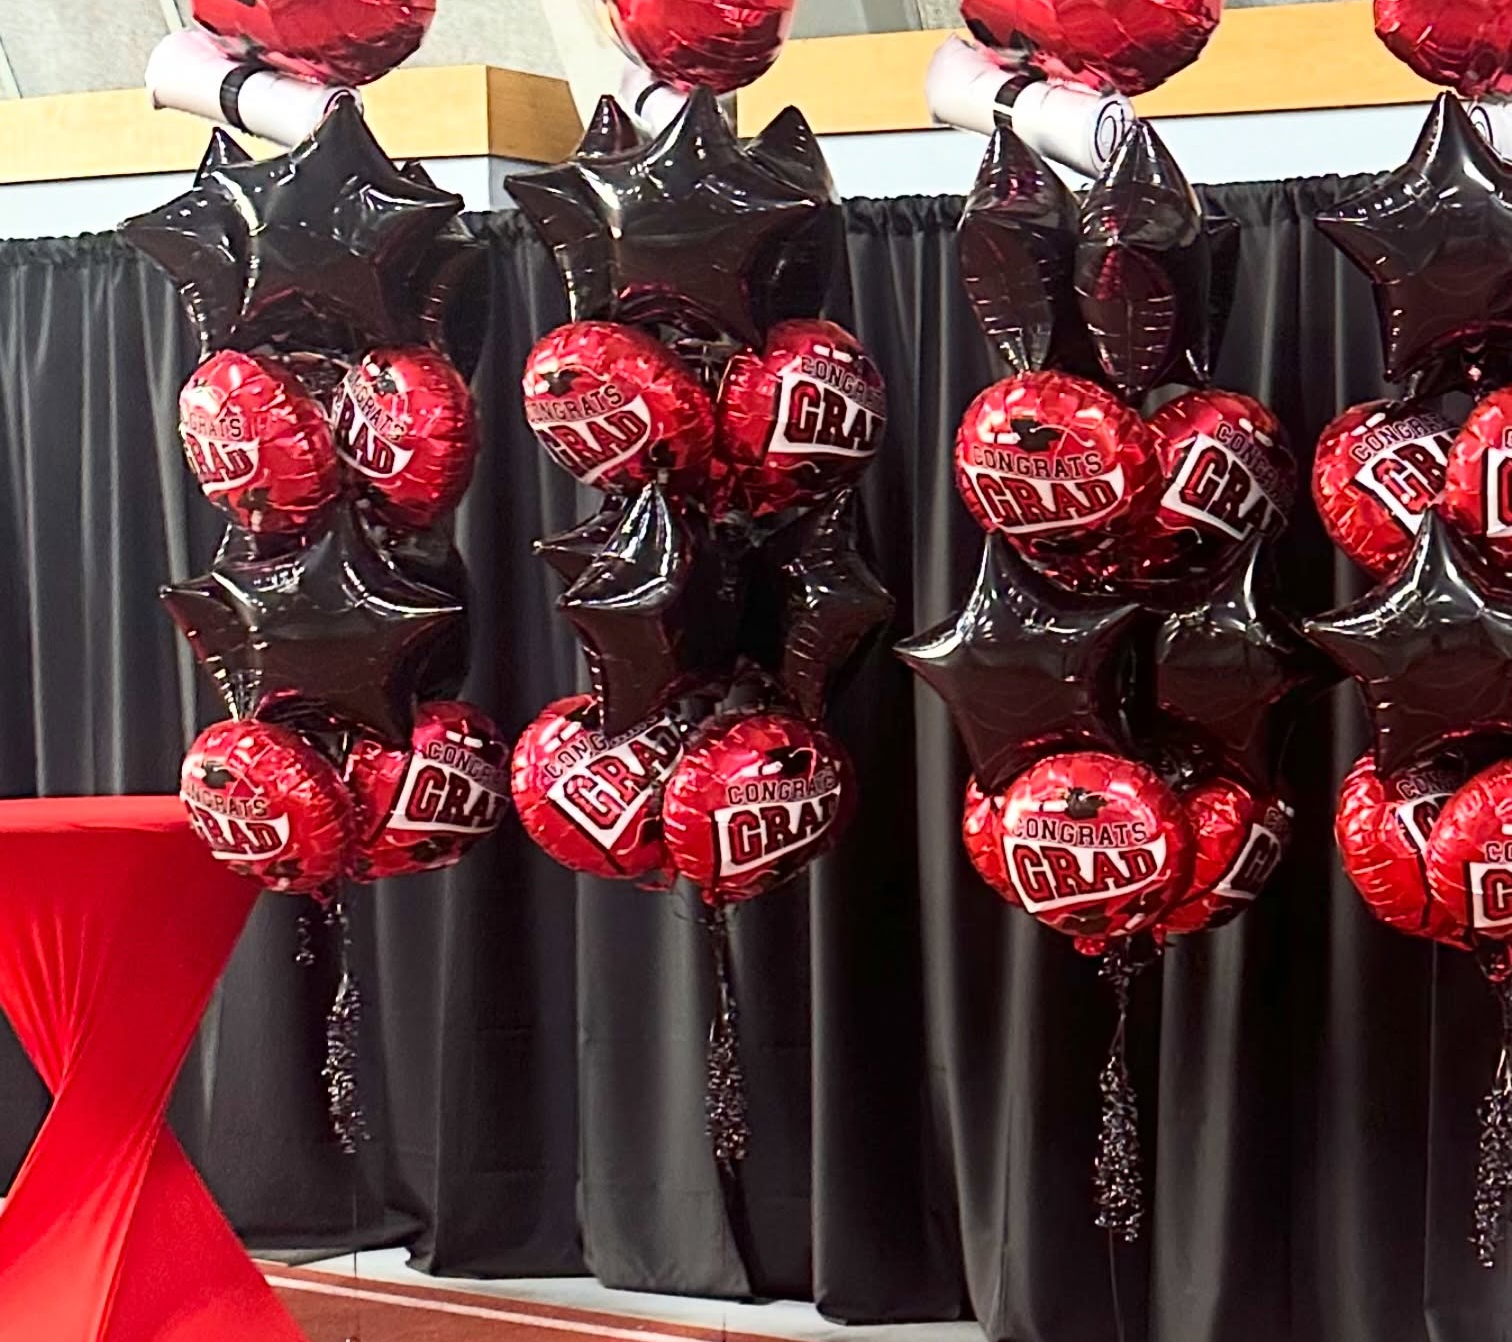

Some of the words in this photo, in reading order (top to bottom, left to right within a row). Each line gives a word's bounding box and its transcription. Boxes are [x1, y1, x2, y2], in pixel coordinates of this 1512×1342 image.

[184, 432, 255, 484] RAD
[972, 444, 1104, 479] CONGRATS
[976, 472, 1120, 528] GRAD
[1013, 817, 1148, 846] CONGRATS
[1012, 844, 1159, 903] GRAD
